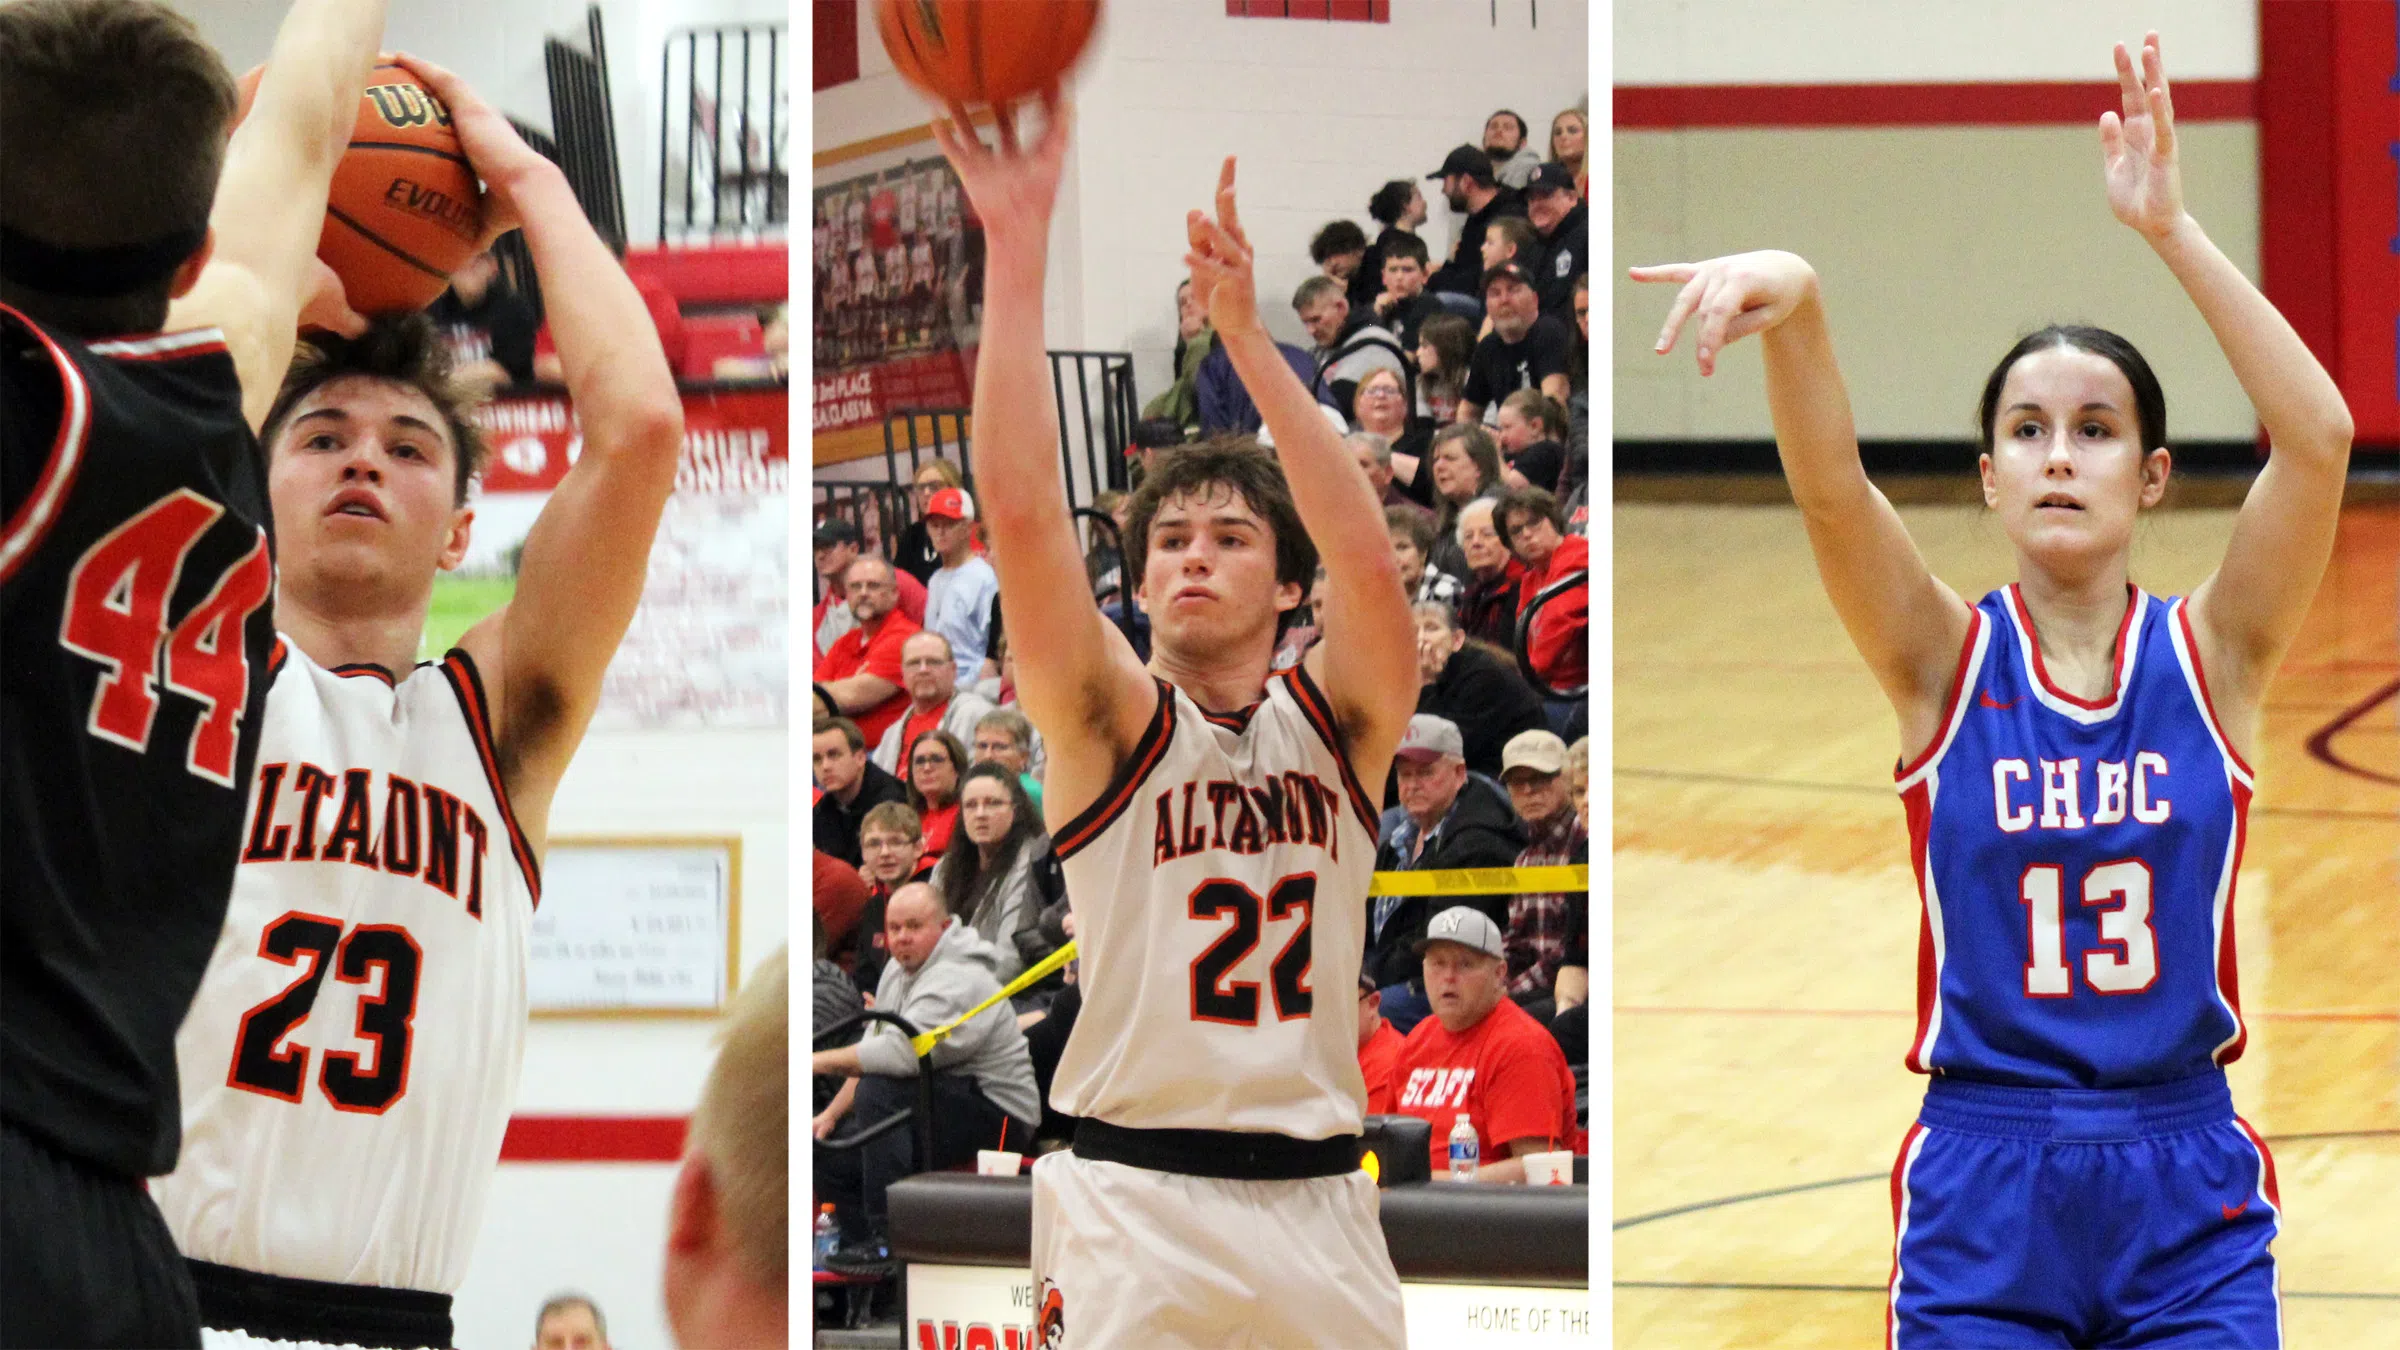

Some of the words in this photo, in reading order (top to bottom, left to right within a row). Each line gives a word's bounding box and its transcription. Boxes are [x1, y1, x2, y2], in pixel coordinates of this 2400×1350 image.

[59, 486, 271, 789] 44
[1992, 750, 2172, 833] CHBC
[1188, 871, 1317, 1027] 22
[1440, 912, 1464, 934] N
[2018, 857, 2160, 998] 13
[226, 910, 423, 1116] 23
[1401, 1067, 1476, 1108] STAFF
[1467, 1304, 1521, 1332] HOME
[1528, 1308, 1551, 1332] OF
